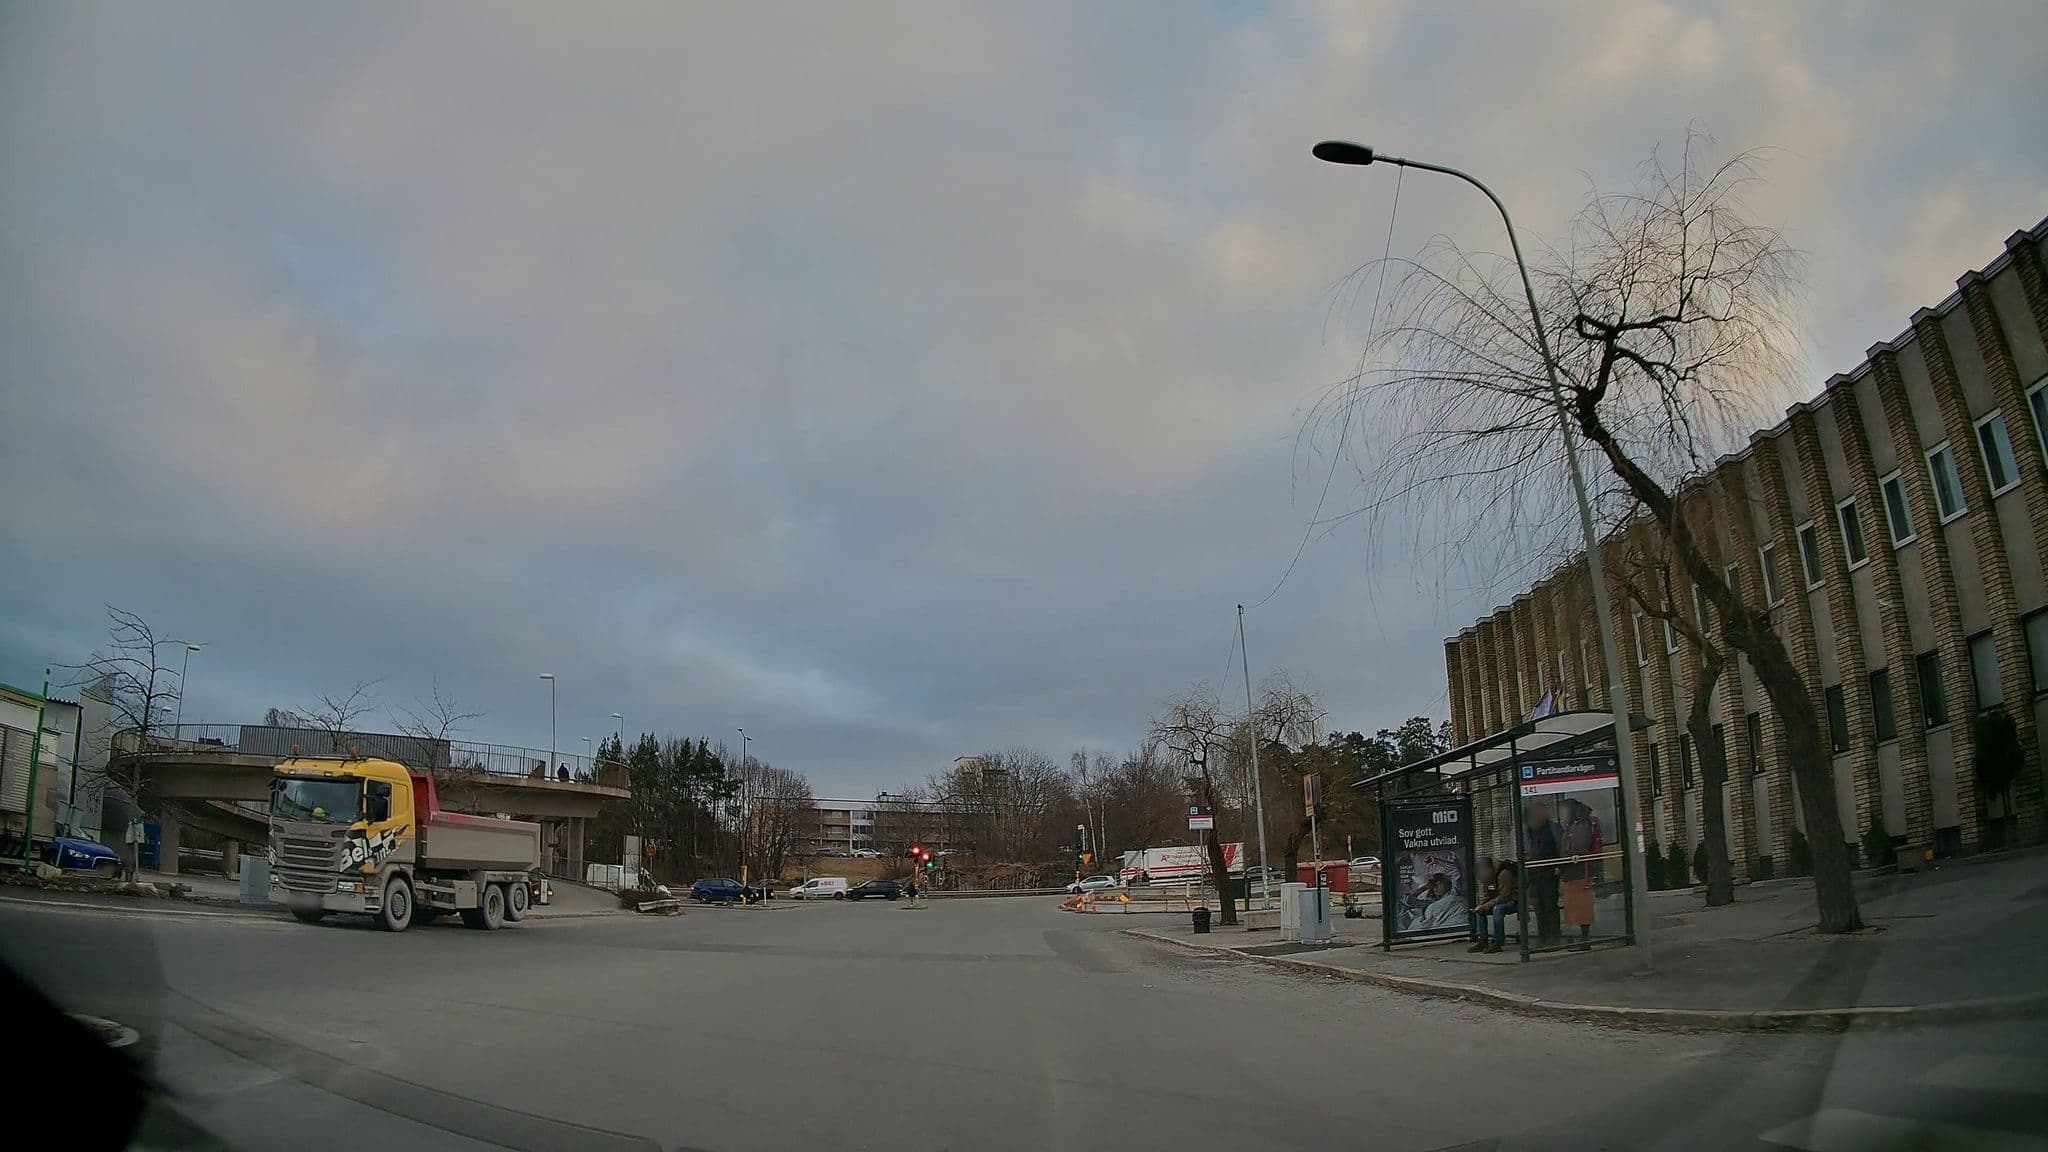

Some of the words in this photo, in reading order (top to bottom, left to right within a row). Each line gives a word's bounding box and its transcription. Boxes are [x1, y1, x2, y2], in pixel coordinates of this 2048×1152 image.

[1536, 764, 1595, 775] Partihandlarvägen
[1525, 786, 1537, 794] 141
[1399, 828, 1414, 838] Sov
[1415, 828, 1434, 838] gott.
[1404, 838, 1428, 848] Vakna
[1430, 835, 1459, 846] utvilad.
